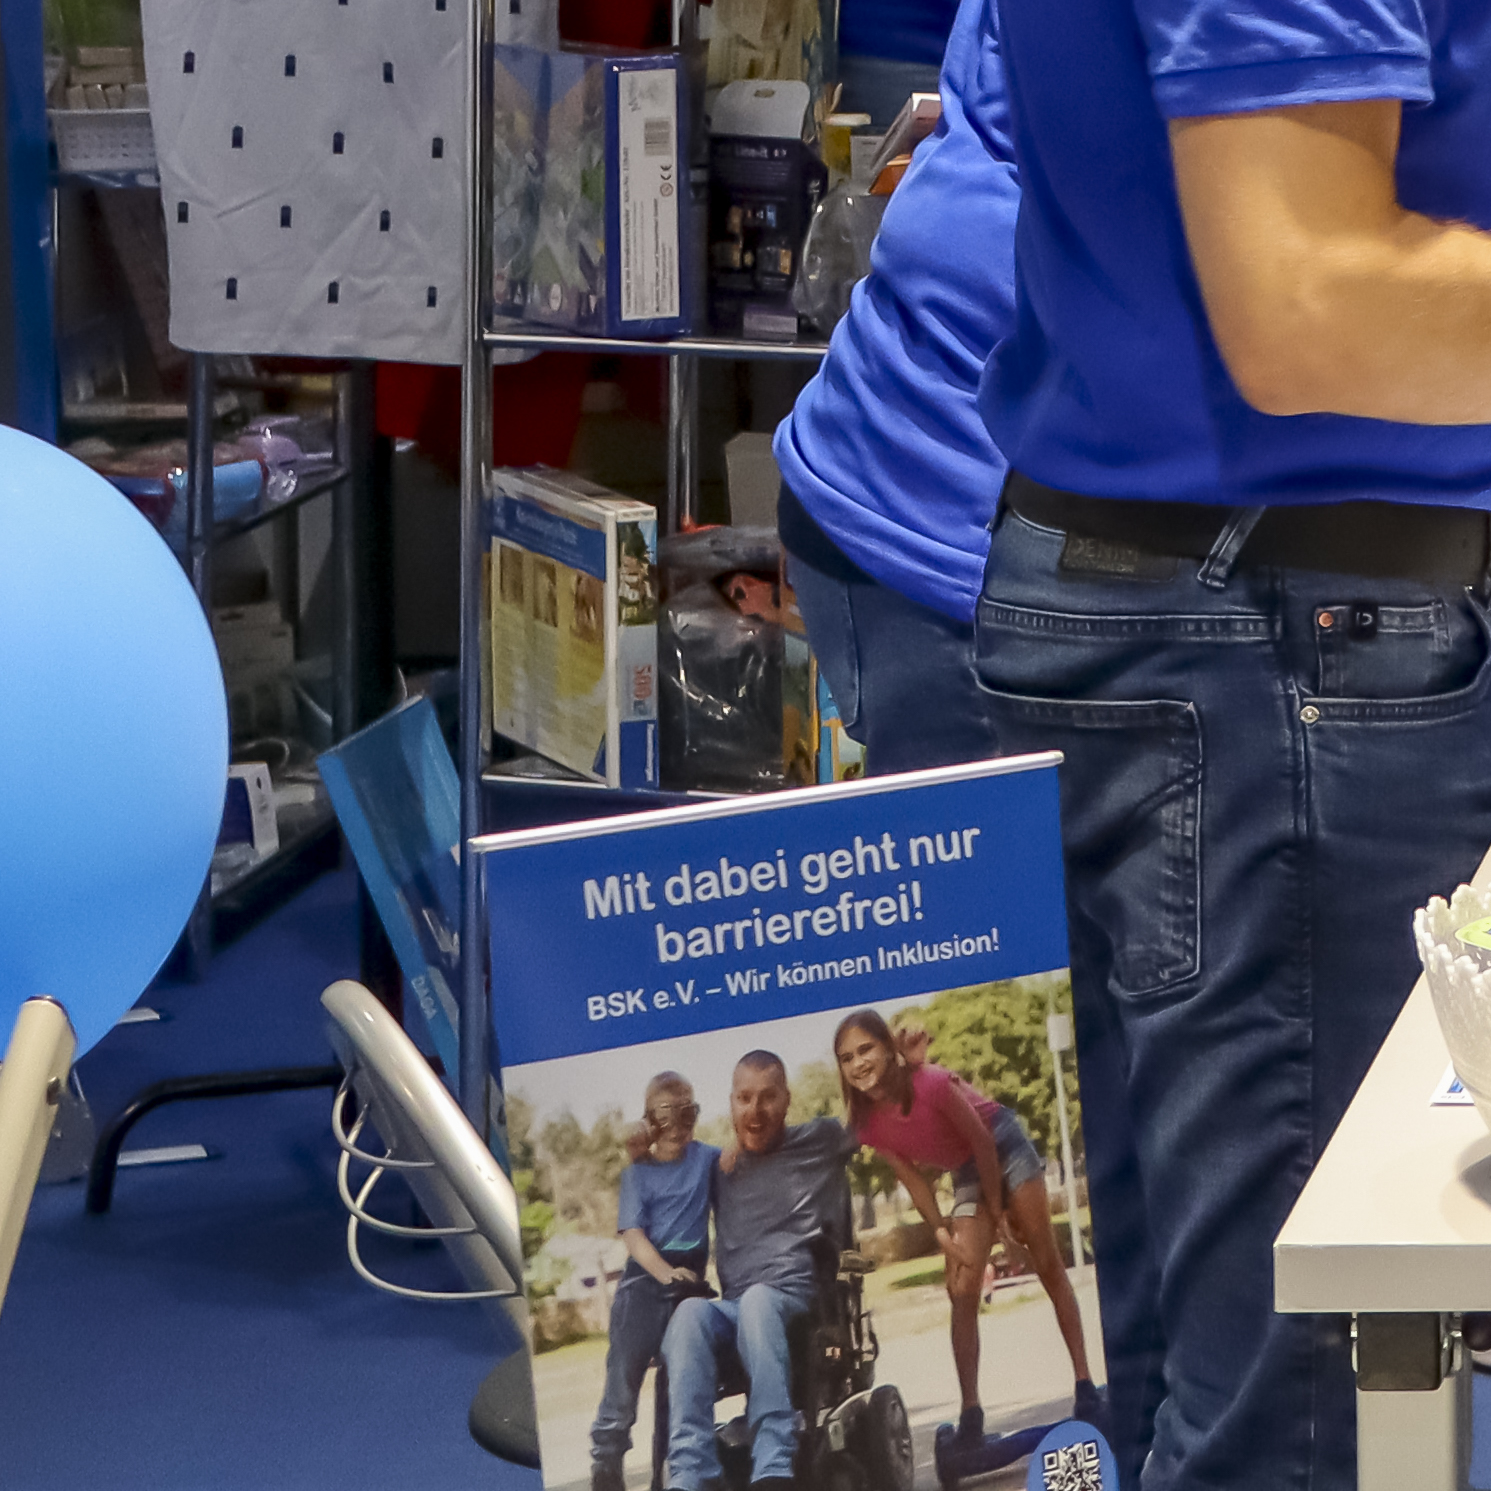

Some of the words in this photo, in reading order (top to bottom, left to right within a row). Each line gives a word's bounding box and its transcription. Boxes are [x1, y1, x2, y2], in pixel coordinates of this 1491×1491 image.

[583, 871, 656, 920] Mit
[664, 849, 789, 907] dabei
[799, 831, 901, 895] geht
[909, 826, 981, 867] nur
[655, 880, 925, 963] barrierefrei!
[587, 987, 648, 1022] BSK
[652, 979, 700, 1010] e.V.
[725, 967, 771, 996] Wir
[777, 952, 873, 989] können
[877, 926, 1000, 971] Inklusion!
